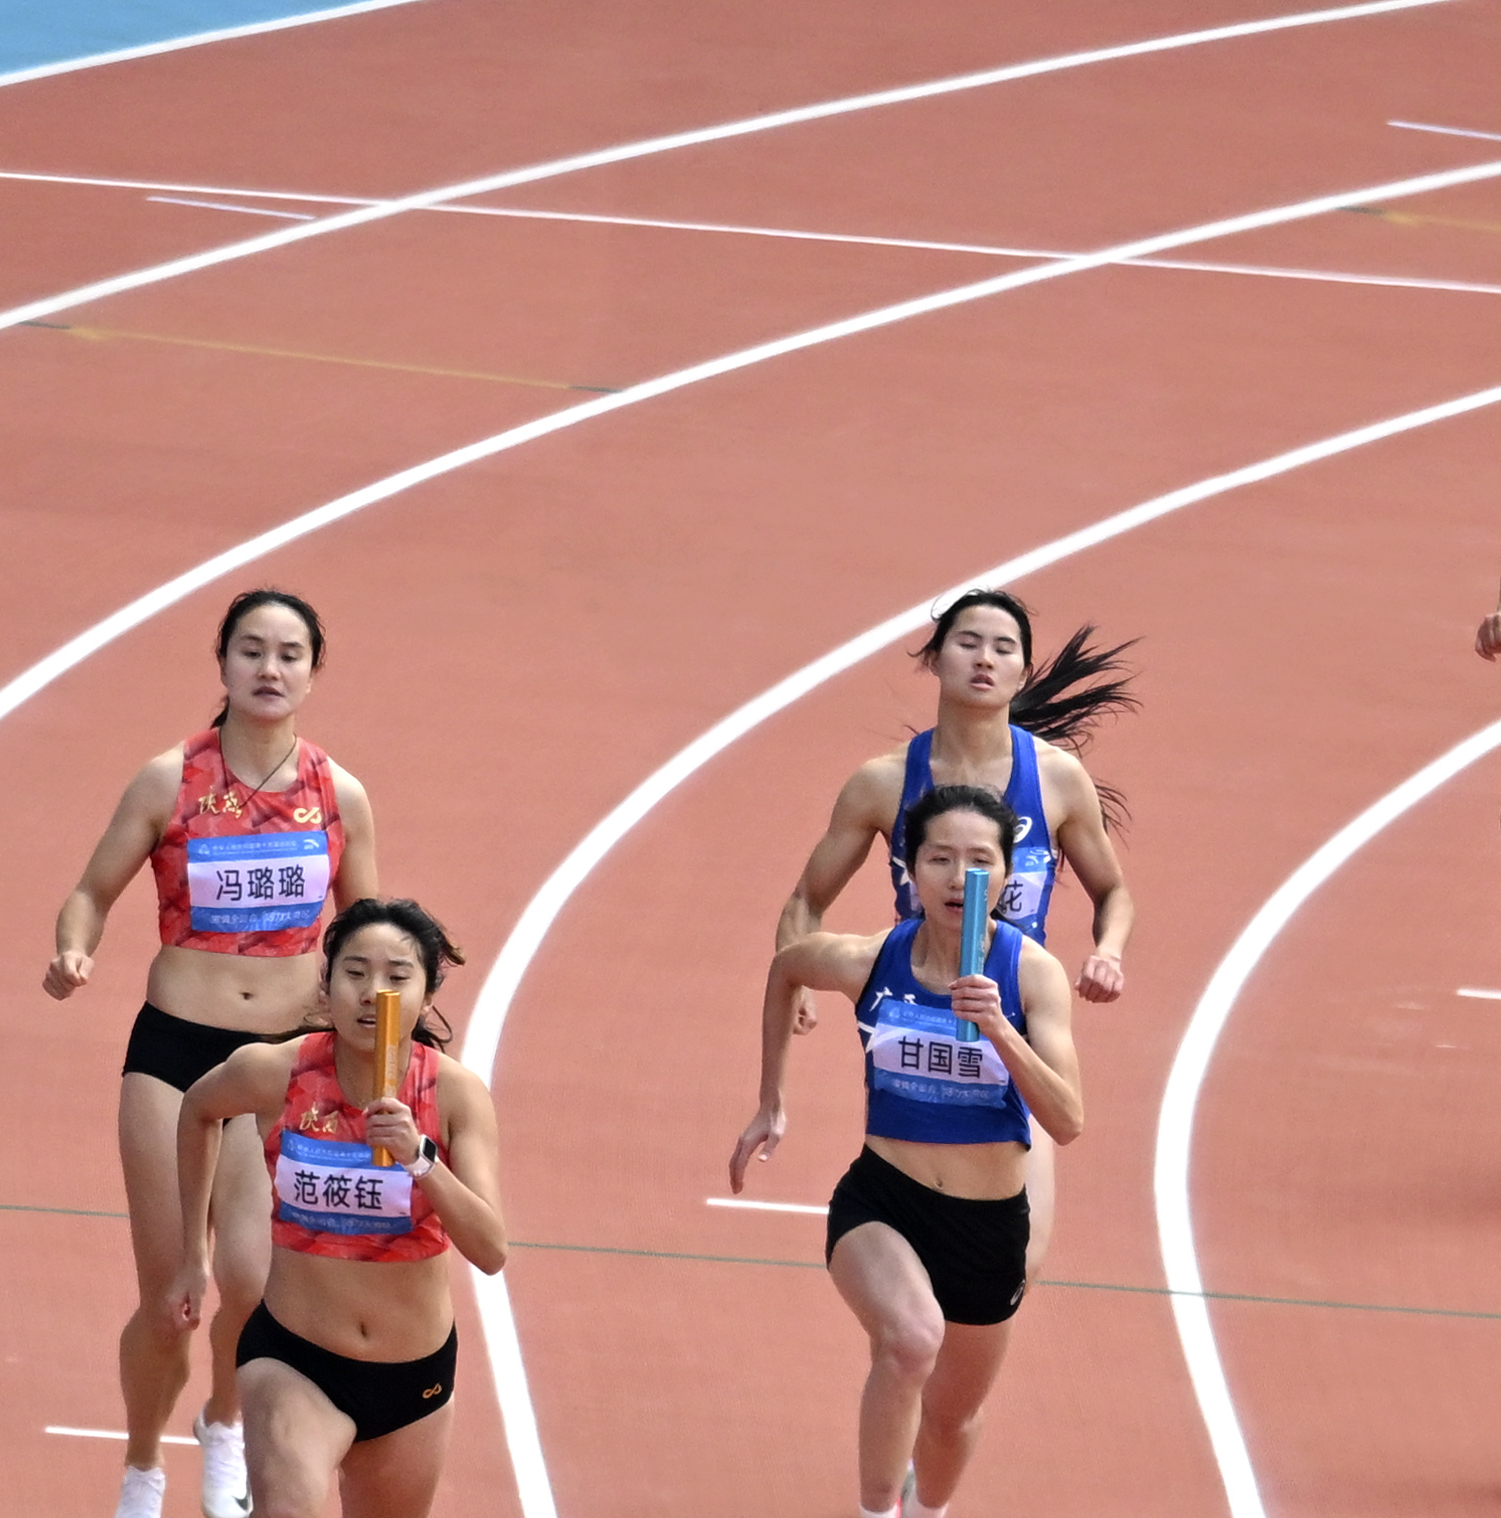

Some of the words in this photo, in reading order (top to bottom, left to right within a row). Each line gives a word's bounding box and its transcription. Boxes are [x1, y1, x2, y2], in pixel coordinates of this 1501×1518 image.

[216, 864, 305, 901] 冯璐璐
[898, 1036, 983, 1079] 甘国雪
[294, 1170, 384, 1211] 范筱钰
